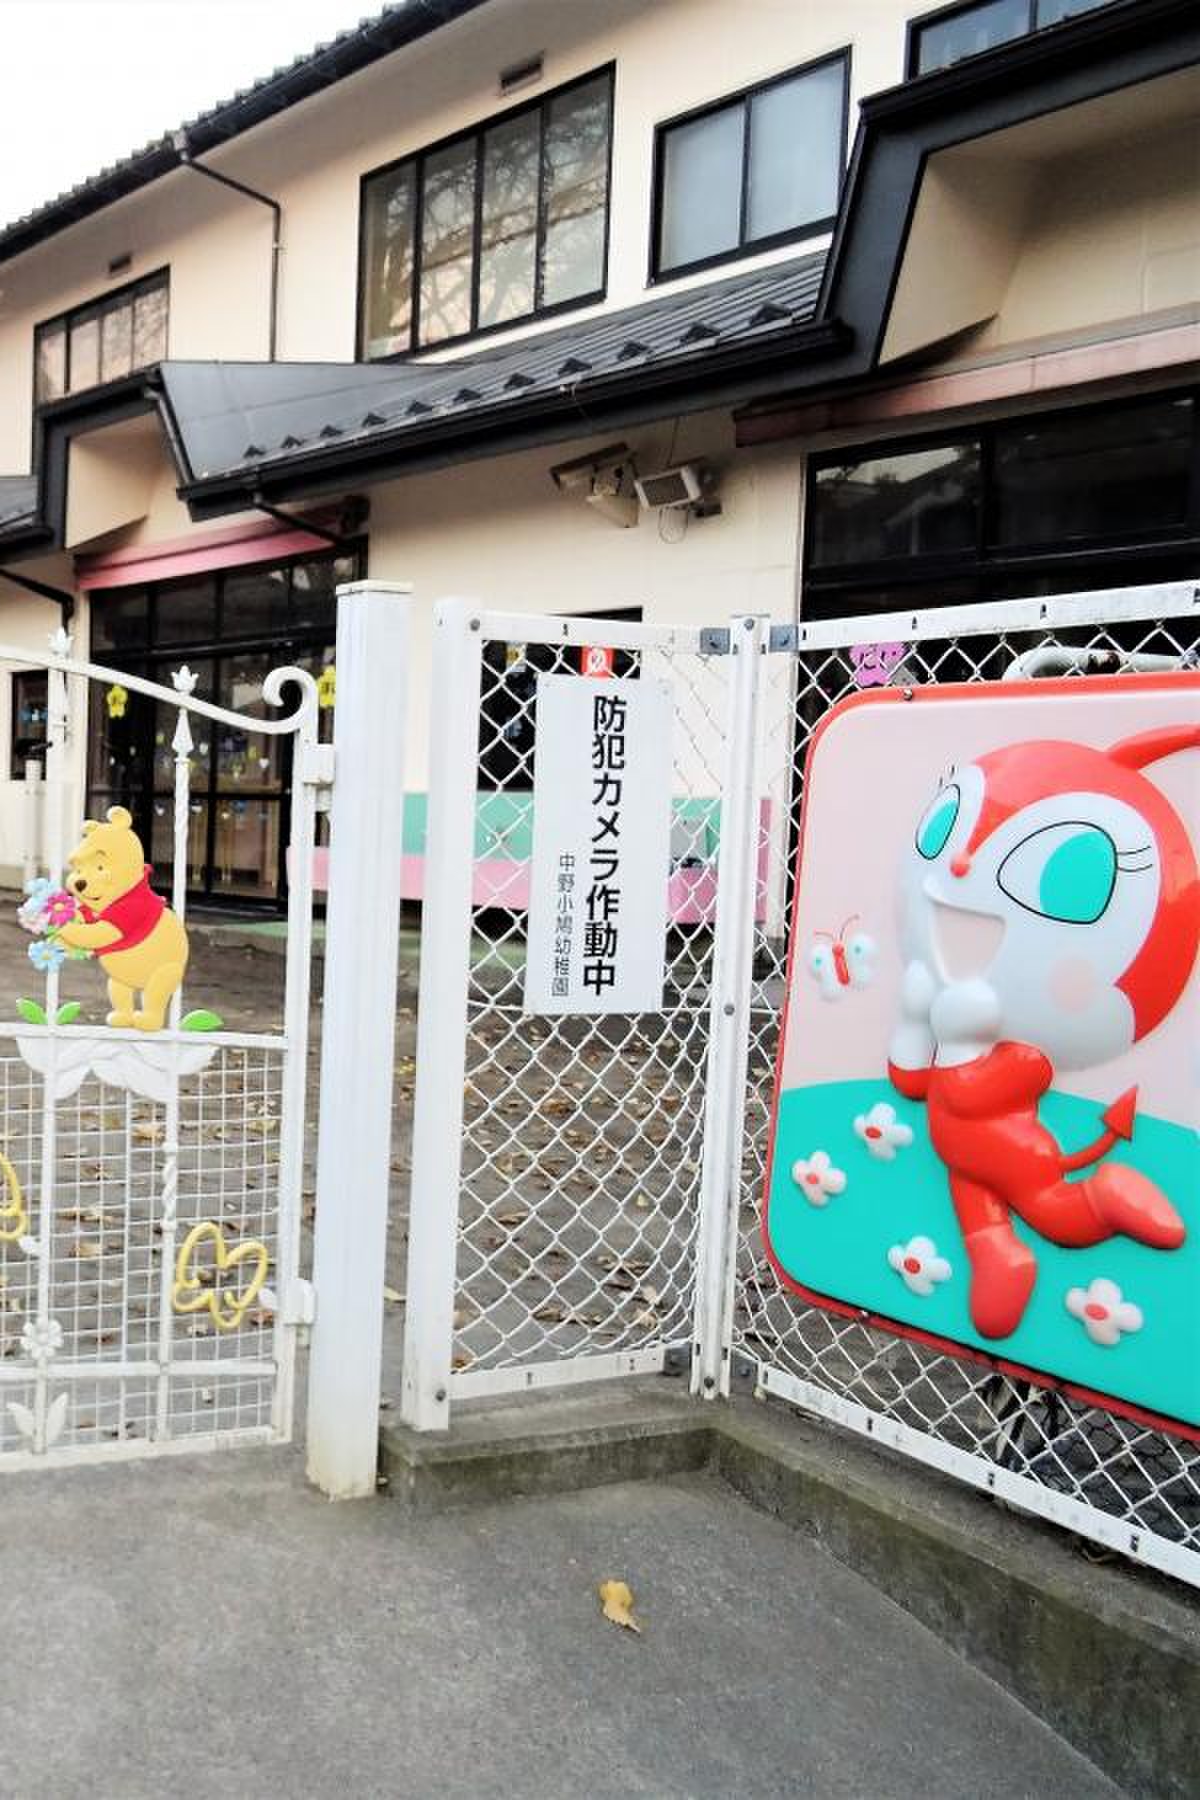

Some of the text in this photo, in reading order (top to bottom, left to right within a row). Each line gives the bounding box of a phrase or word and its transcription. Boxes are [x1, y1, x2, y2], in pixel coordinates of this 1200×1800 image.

[582, 694, 627, 997] 防犯カメラ作動中
